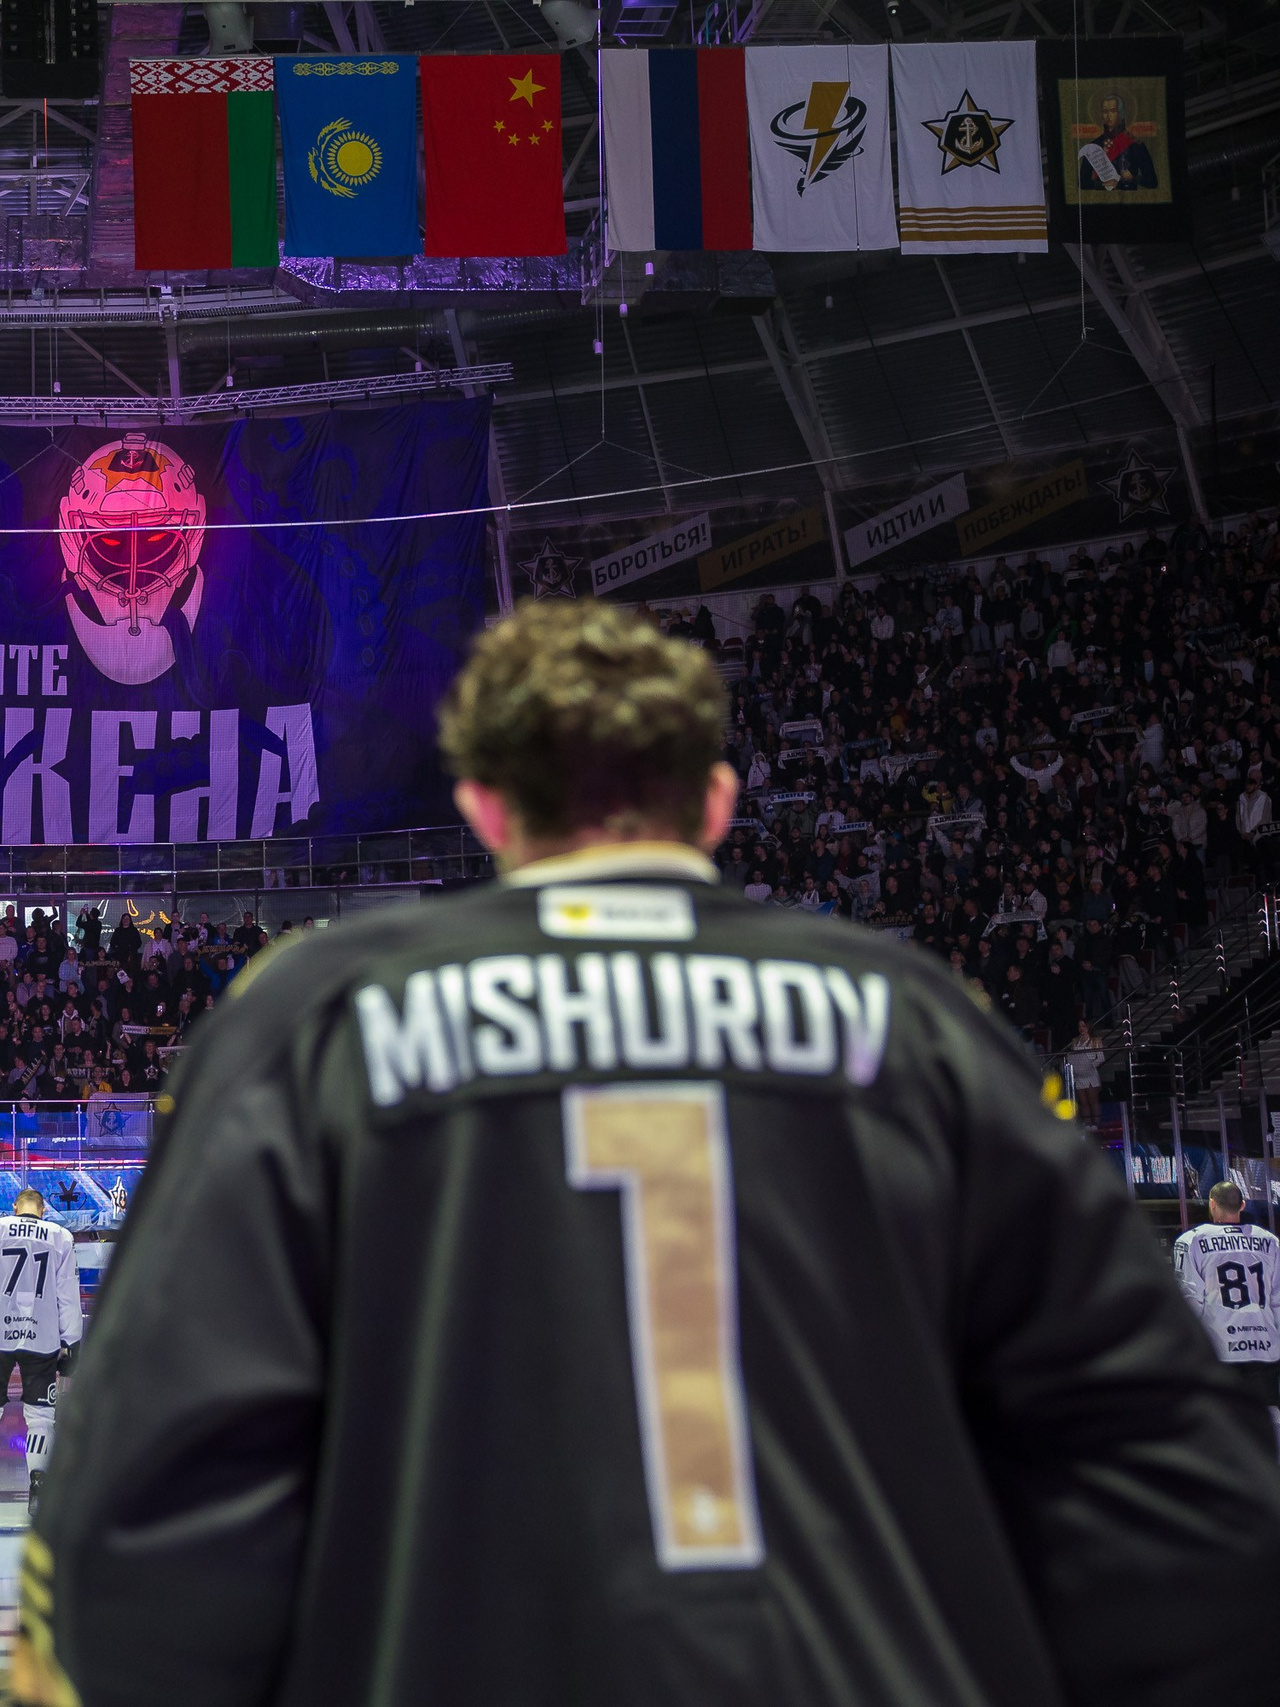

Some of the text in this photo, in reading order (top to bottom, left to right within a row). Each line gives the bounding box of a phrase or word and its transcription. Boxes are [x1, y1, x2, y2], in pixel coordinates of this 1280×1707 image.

[867, 494, 946, 548] ИДТИ И
[963, 469, 1083, 542] ПОБЕЖДАТЬ!
[594, 522, 708, 587] БОРОТЬСЯ!
[721, 518, 807, 573] ИГРАТЬ!
[356, 951, 891, 1107] MISHUROV
[8, 1223, 49, 1241] SAFIN
[1198, 1235, 1271, 1254] BLAZHIYEVSKY
[2, 1247, 49, 1299] 71
[1217, 1261, 1266, 1309] 81
[562, 1080, 765, 1572] 1
